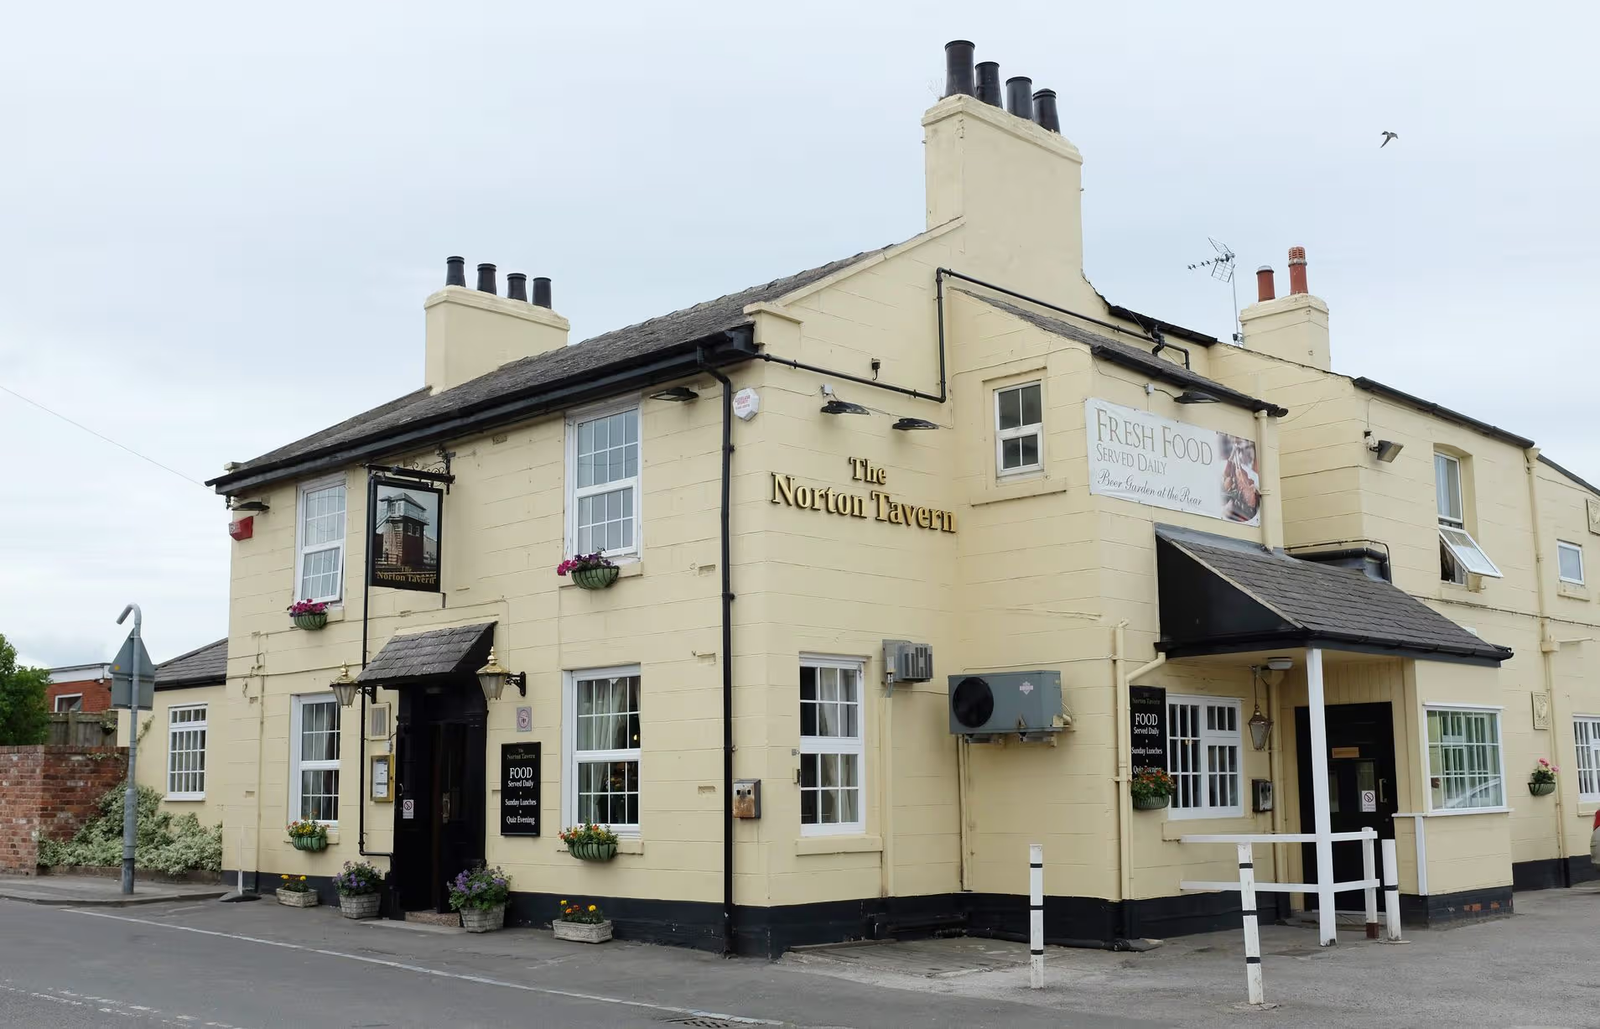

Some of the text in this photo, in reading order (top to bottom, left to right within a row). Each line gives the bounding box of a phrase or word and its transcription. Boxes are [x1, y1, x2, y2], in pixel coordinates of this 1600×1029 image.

[1095, 407, 1213, 466] FRESH FOOD
[1096, 443, 1167, 476] SERVED DAILY
[849, 457, 886, 485] The
[1097, 468, 1202, 506] Beer Garden at the Rear
[771, 472, 956, 533] Norton Tavern
[376, 570, 436, 584] Norton Tavern
[1135, 713, 1158, 726] FOOD
[1133, 726, 1159, 737] Served Daily
[1131, 746, 1163, 756] Sunday Lunches
[509, 766, 533, 779] FOOD
[523, 780, 534, 789] Daily
[505, 798, 537, 807] Sunday Lunches
[506, 815, 535, 825] Quiz Evening
